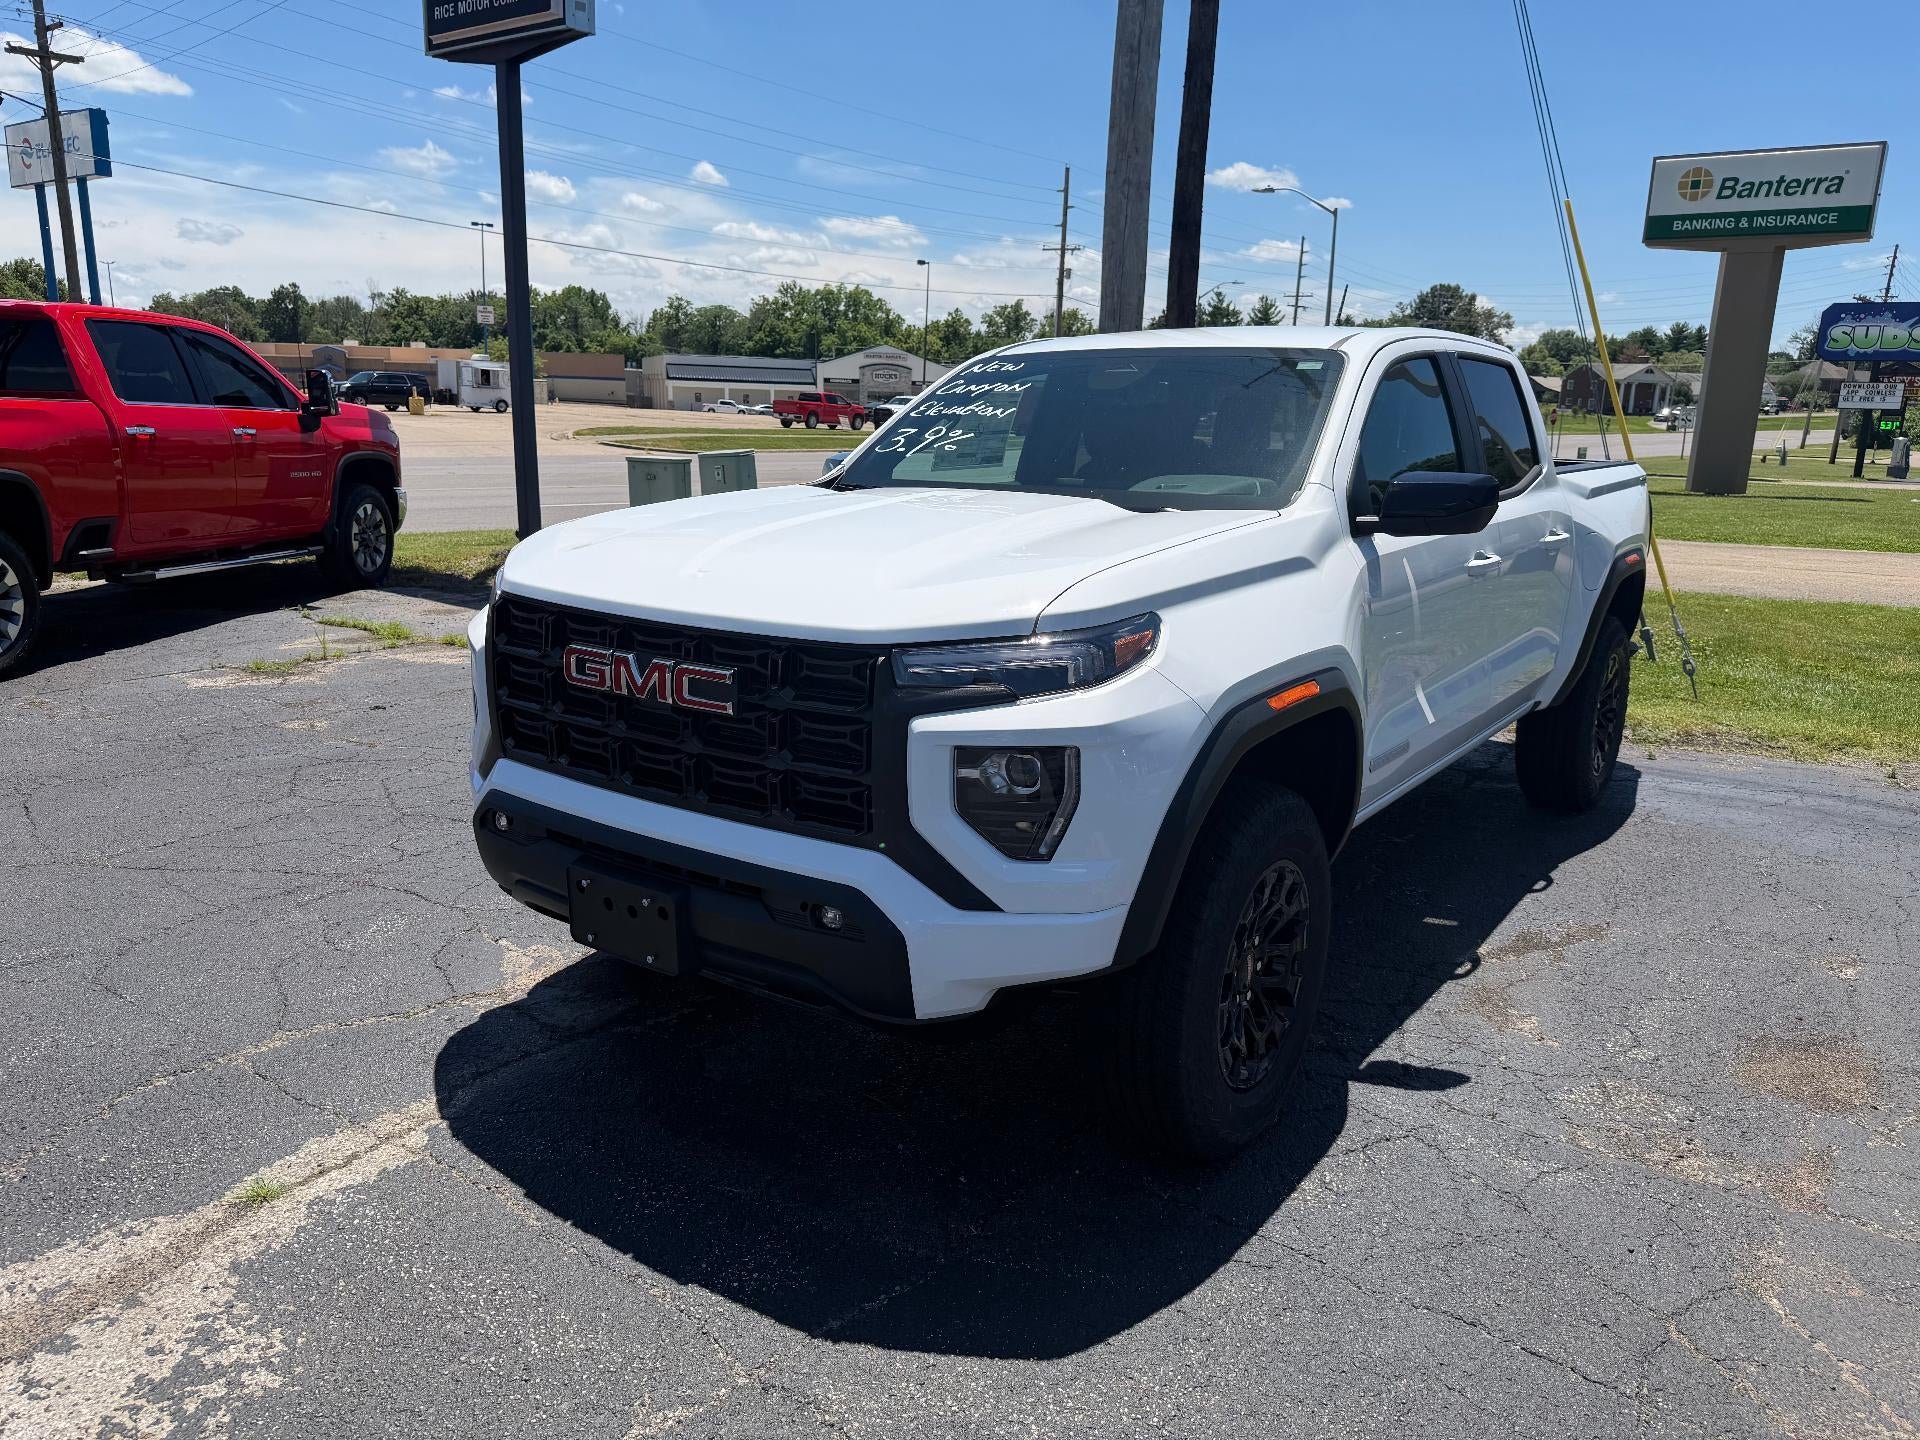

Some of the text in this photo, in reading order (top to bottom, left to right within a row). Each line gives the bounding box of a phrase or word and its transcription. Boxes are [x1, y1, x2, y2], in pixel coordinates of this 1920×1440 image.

[434, 3, 455, 20] RICE
[458, 0, 490, 15] MOTOR
[1716, 174, 1845, 200] Banterra
[1672, 212, 1839, 231] BANKING & INSURANCE
[960, 360, 1025, 376] NEW
[875, 421, 975, 458] 3.9%
[563, 641, 737, 716] GMC
